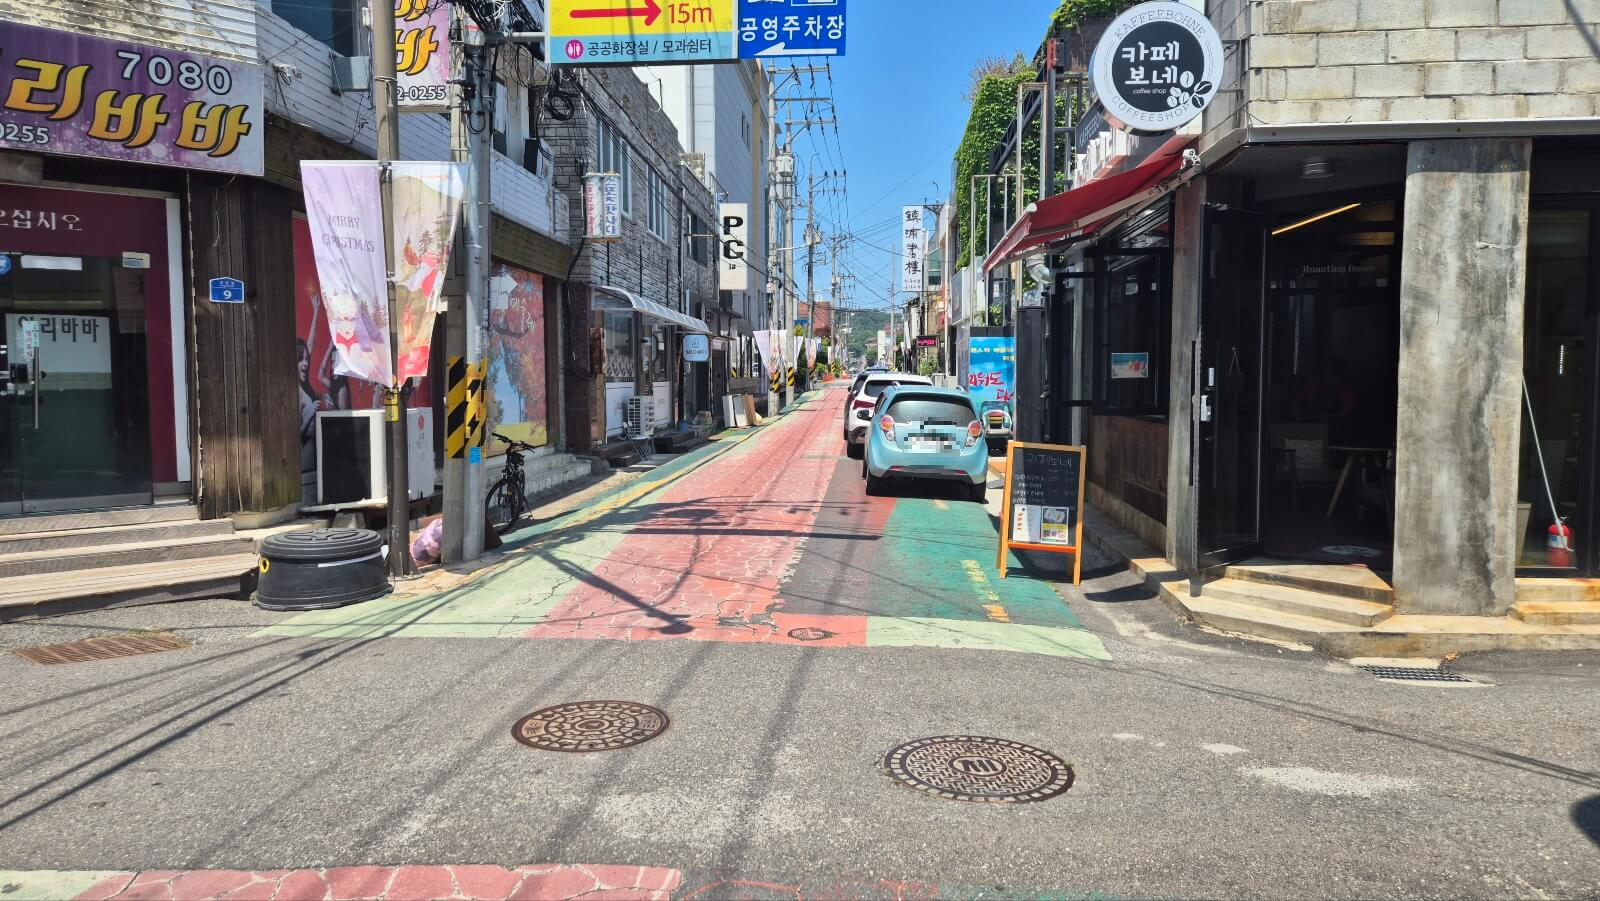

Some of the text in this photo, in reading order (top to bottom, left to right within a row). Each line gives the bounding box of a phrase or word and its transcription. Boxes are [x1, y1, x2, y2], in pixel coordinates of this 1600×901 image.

[668, 3, 712, 24] 15m
[740, 15, 845, 42] 공영주차장
[1114, 9, 1206, 40] KAFFEEBOHNE
[588, 40, 649, 56] 공공화장실
[662, 38, 712, 54] 모과쉼터
[1121, 41, 1180, 62] 카페
[117, 50, 232, 95] 7080
[1125, 65, 1178, 85] 보네
[1112, 95, 1191, 122] COFFEESHOP
[223, 290, 232, 300] 9
